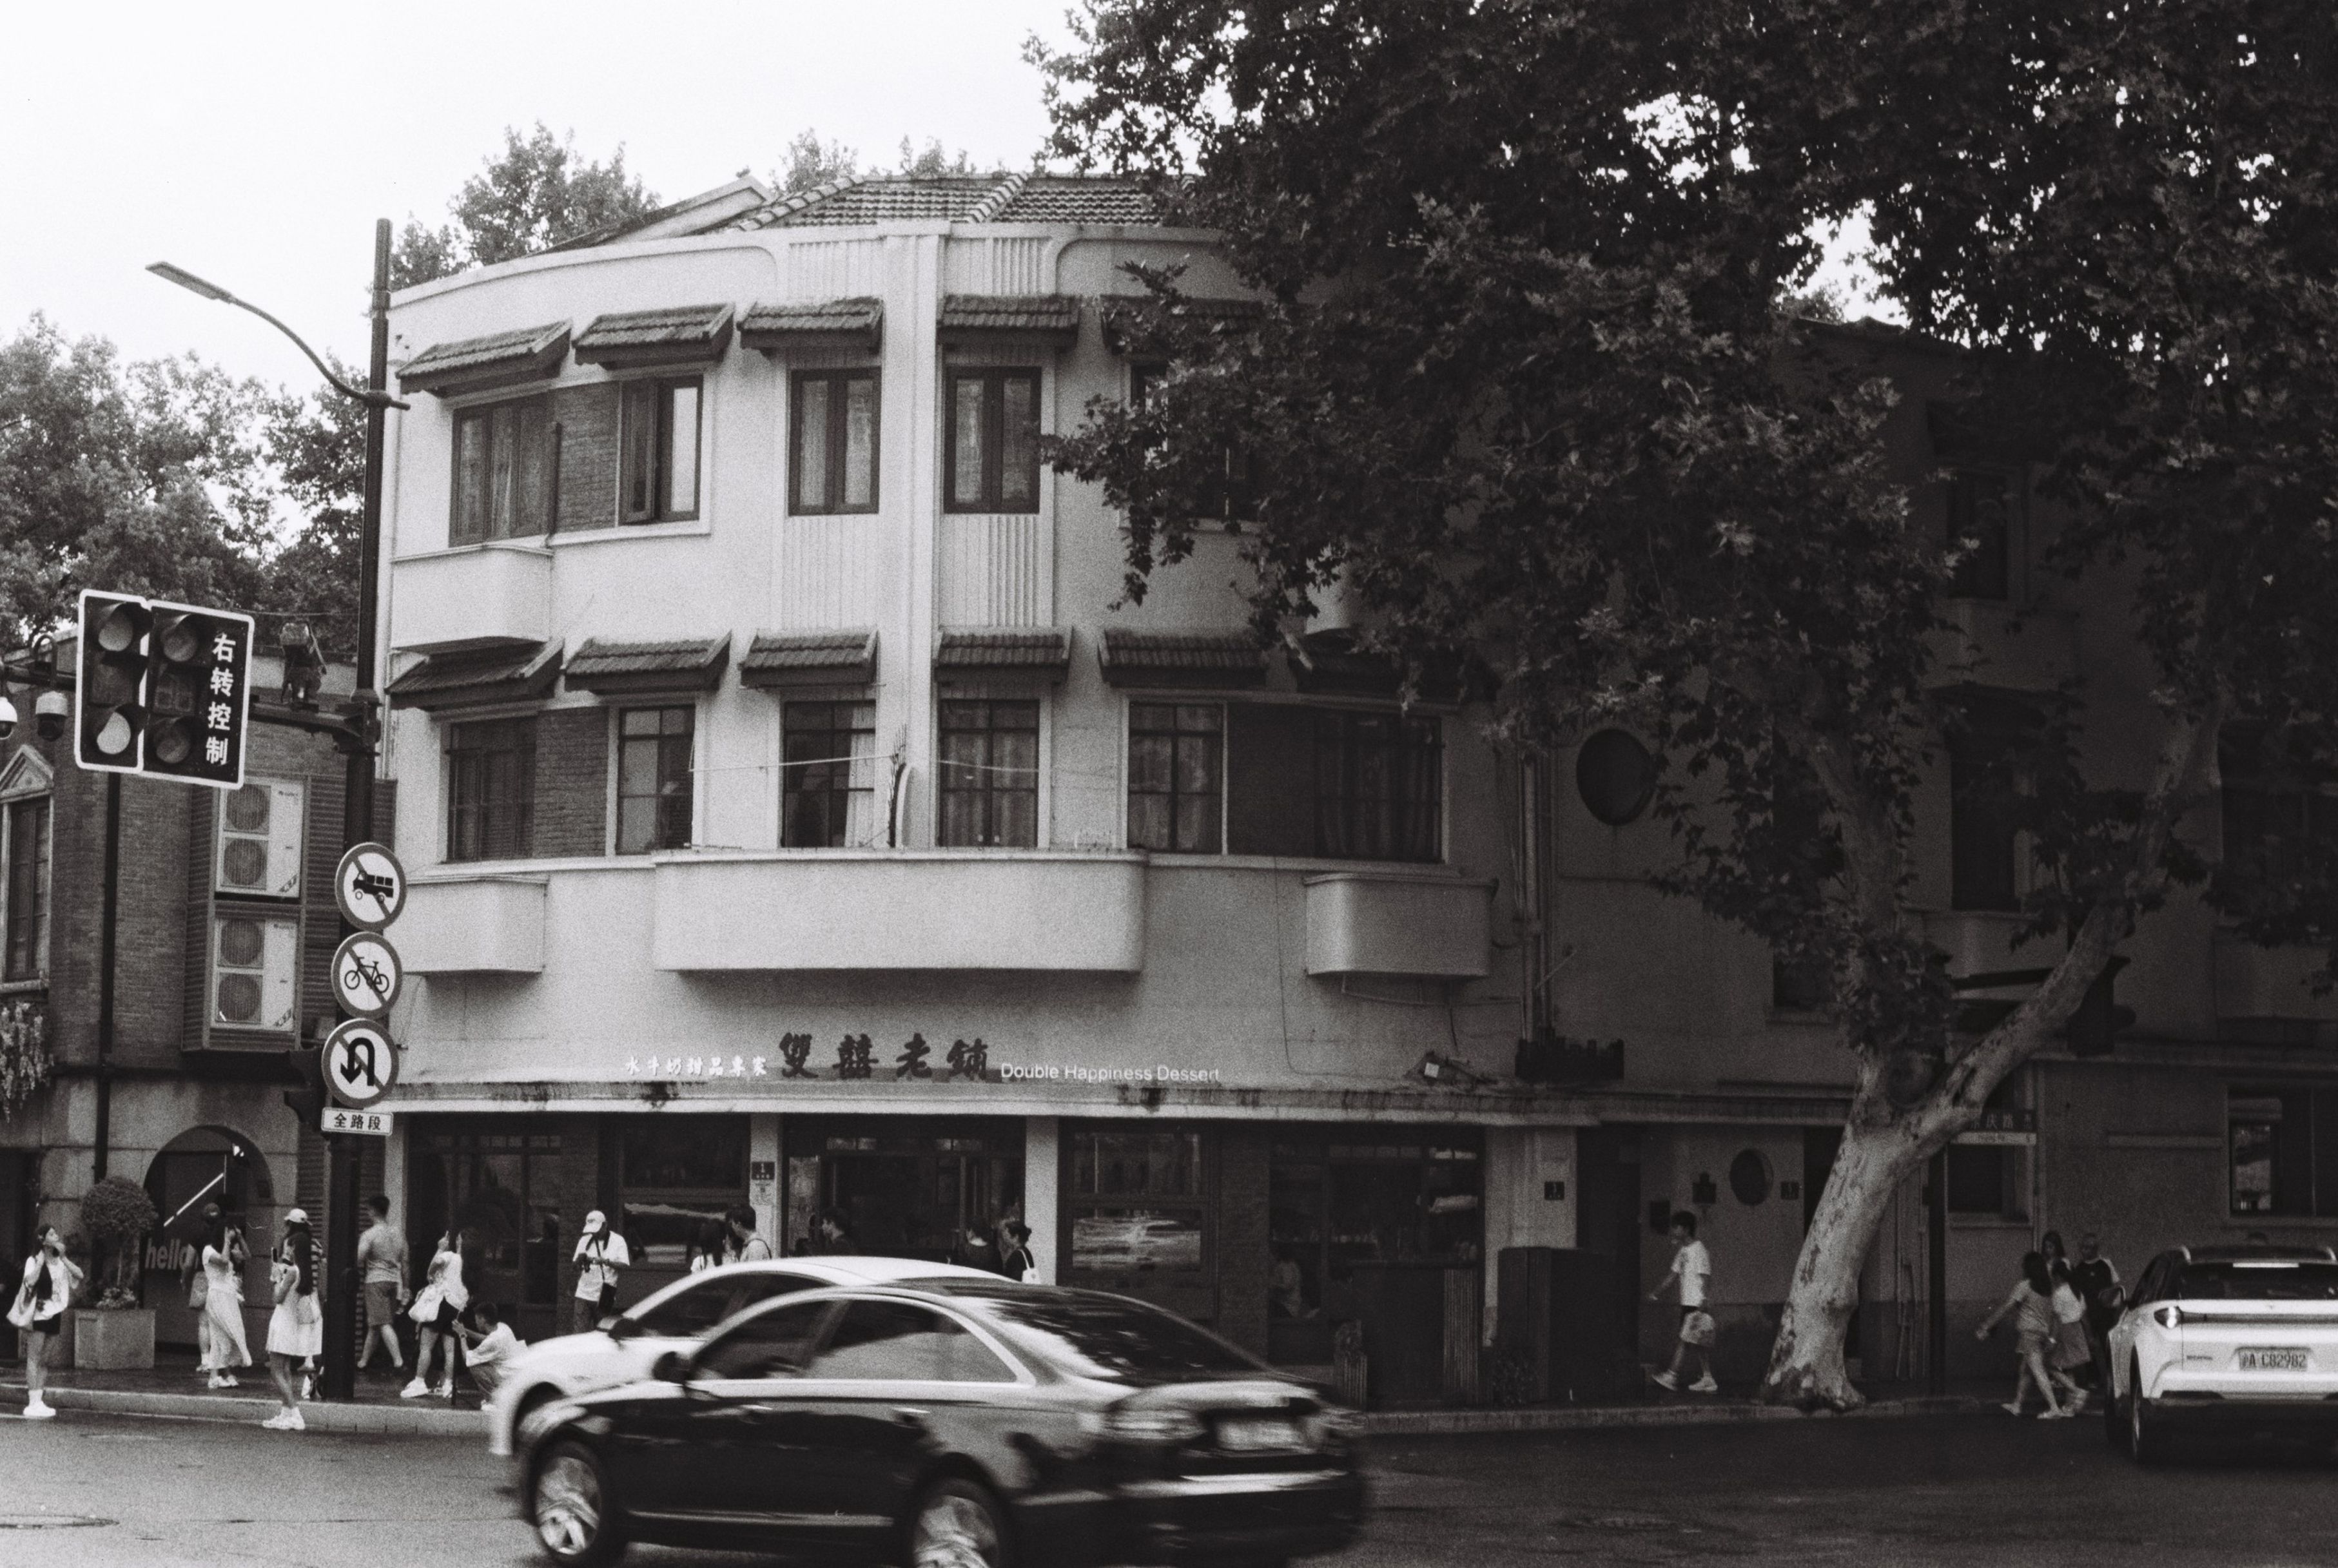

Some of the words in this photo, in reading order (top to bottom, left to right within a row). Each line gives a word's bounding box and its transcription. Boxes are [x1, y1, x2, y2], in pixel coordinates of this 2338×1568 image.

[205, 632, 237, 766] 右转控制
[1000, 1063, 1059, 1079] Double
[1065, 1064, 1153, 1083] Happiness
[1158, 1065, 1220, 1081] Dessert
[333, 1112, 382, 1131] 全路段
